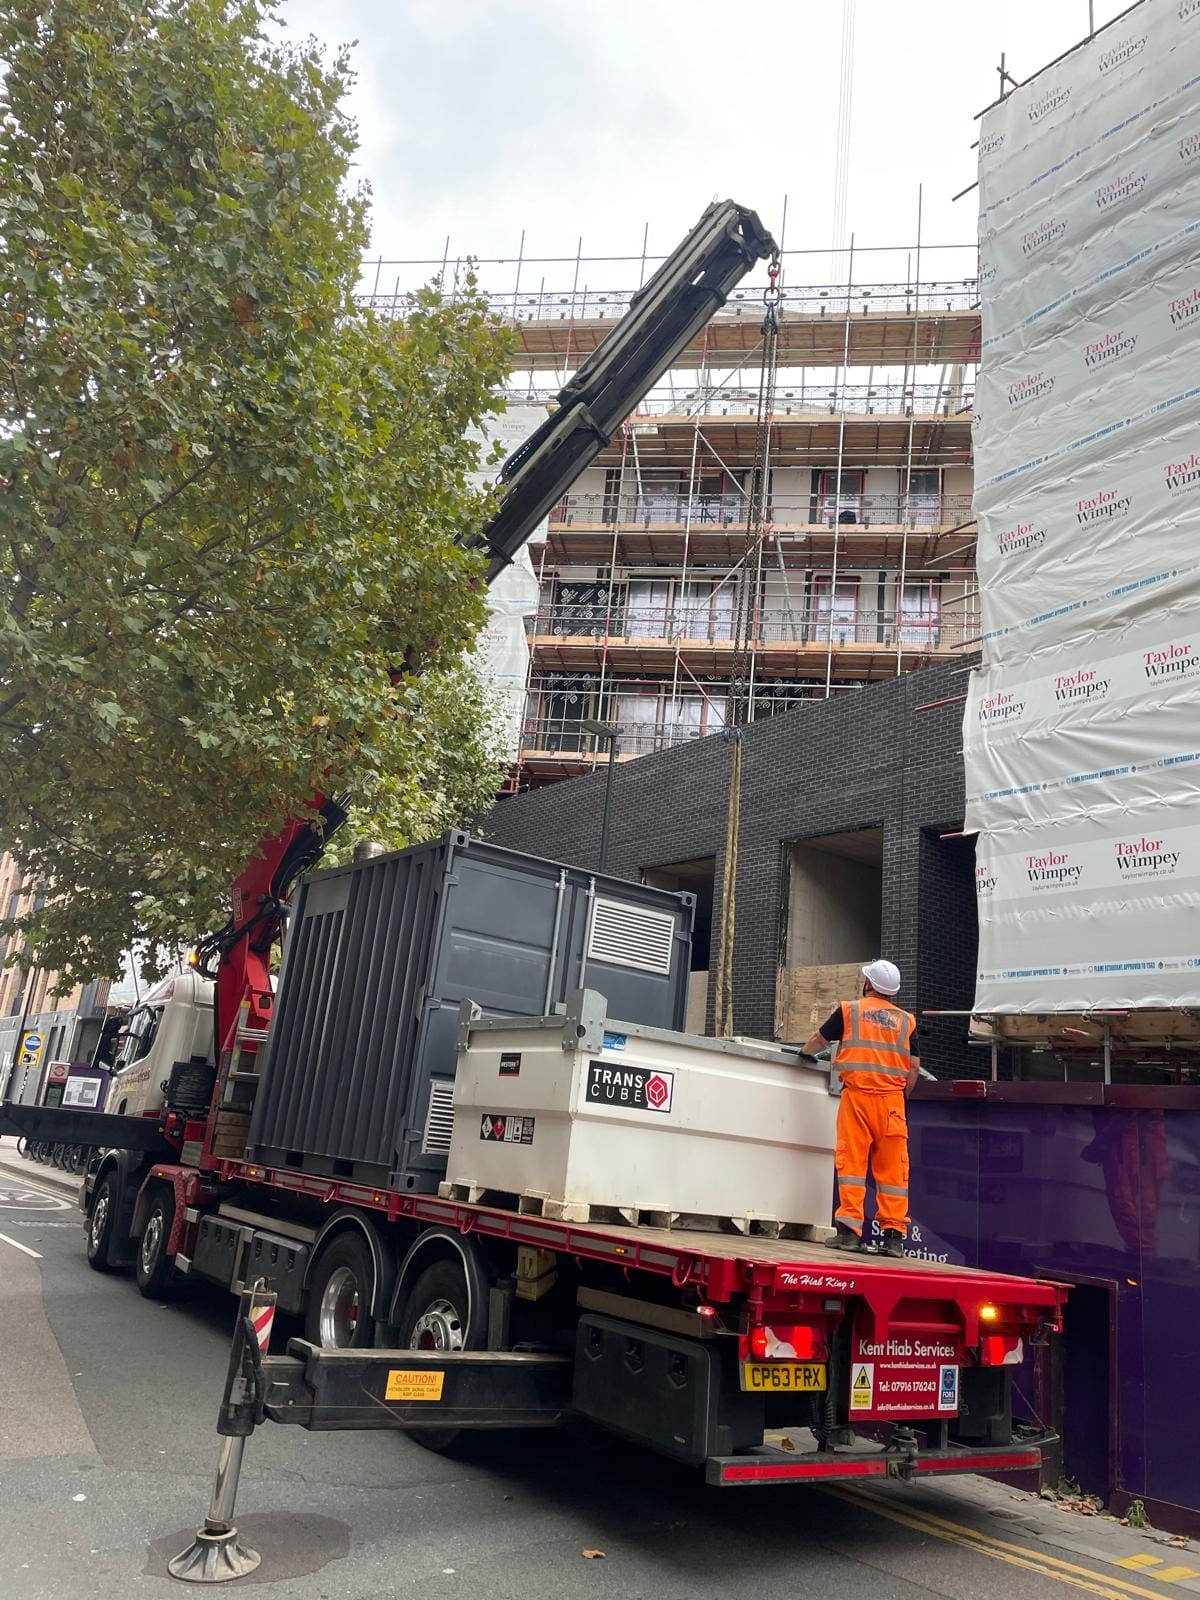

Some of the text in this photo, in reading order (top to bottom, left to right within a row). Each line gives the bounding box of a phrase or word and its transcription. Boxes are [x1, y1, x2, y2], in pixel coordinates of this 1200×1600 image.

[1098, 35, 1148, 72] Wimpey
[1027, 86, 1072, 121] Wimpey
[1095, 170, 1136, 198] Taylor
[1096, 173, 1148, 209] Wimpey
[1022, 217, 1056, 244] Taylor
[1022, 220, 1068, 254] Wimpey
[1083, 330, 1124, 356] Taylor
[1084, 334, 1138, 367] Wimpey
[1007, 372, 1044, 395] Taylor
[1008, 376, 1056, 405] Wimpey
[1075, 490, 1118, 512] Taylor
[1076, 496, 1133, 524] Wimpey
[997, 522, 1034, 544] Taylor
[999, 528, 1048, 555] Wimpey
[1143, 644, 1191, 666] Taylor
[1055, 670, 1096, 689] Taylor
[1055, 679, 1111, 701] Wimpey
[978, 702, 1026, 721] Wimpey
[979, 692, 1014, 710] Taylor
[1115, 838, 1163, 856] Taylor
[1026, 852, 1068, 869] Taylor
[1116, 852, 1181, 869] Wimpey
[1027, 866, 1083, 881] Wimpey
[593, 1068, 643, 1089] TRANS
[591, 1083, 642, 1103] CUBE
[911, 1225, 922, 1243] &
[781, 1273, 798, 1285] The
[800, 1275, 824, 1286] Hiab
[859, 1339, 955, 1357] Kent Hiab Services
[395, 1374, 437, 1384] CAUTION!
[752, 1367, 820, 1387] CP63 FRX
[878, 1382, 936, 1392] Tel: 07916 176243
